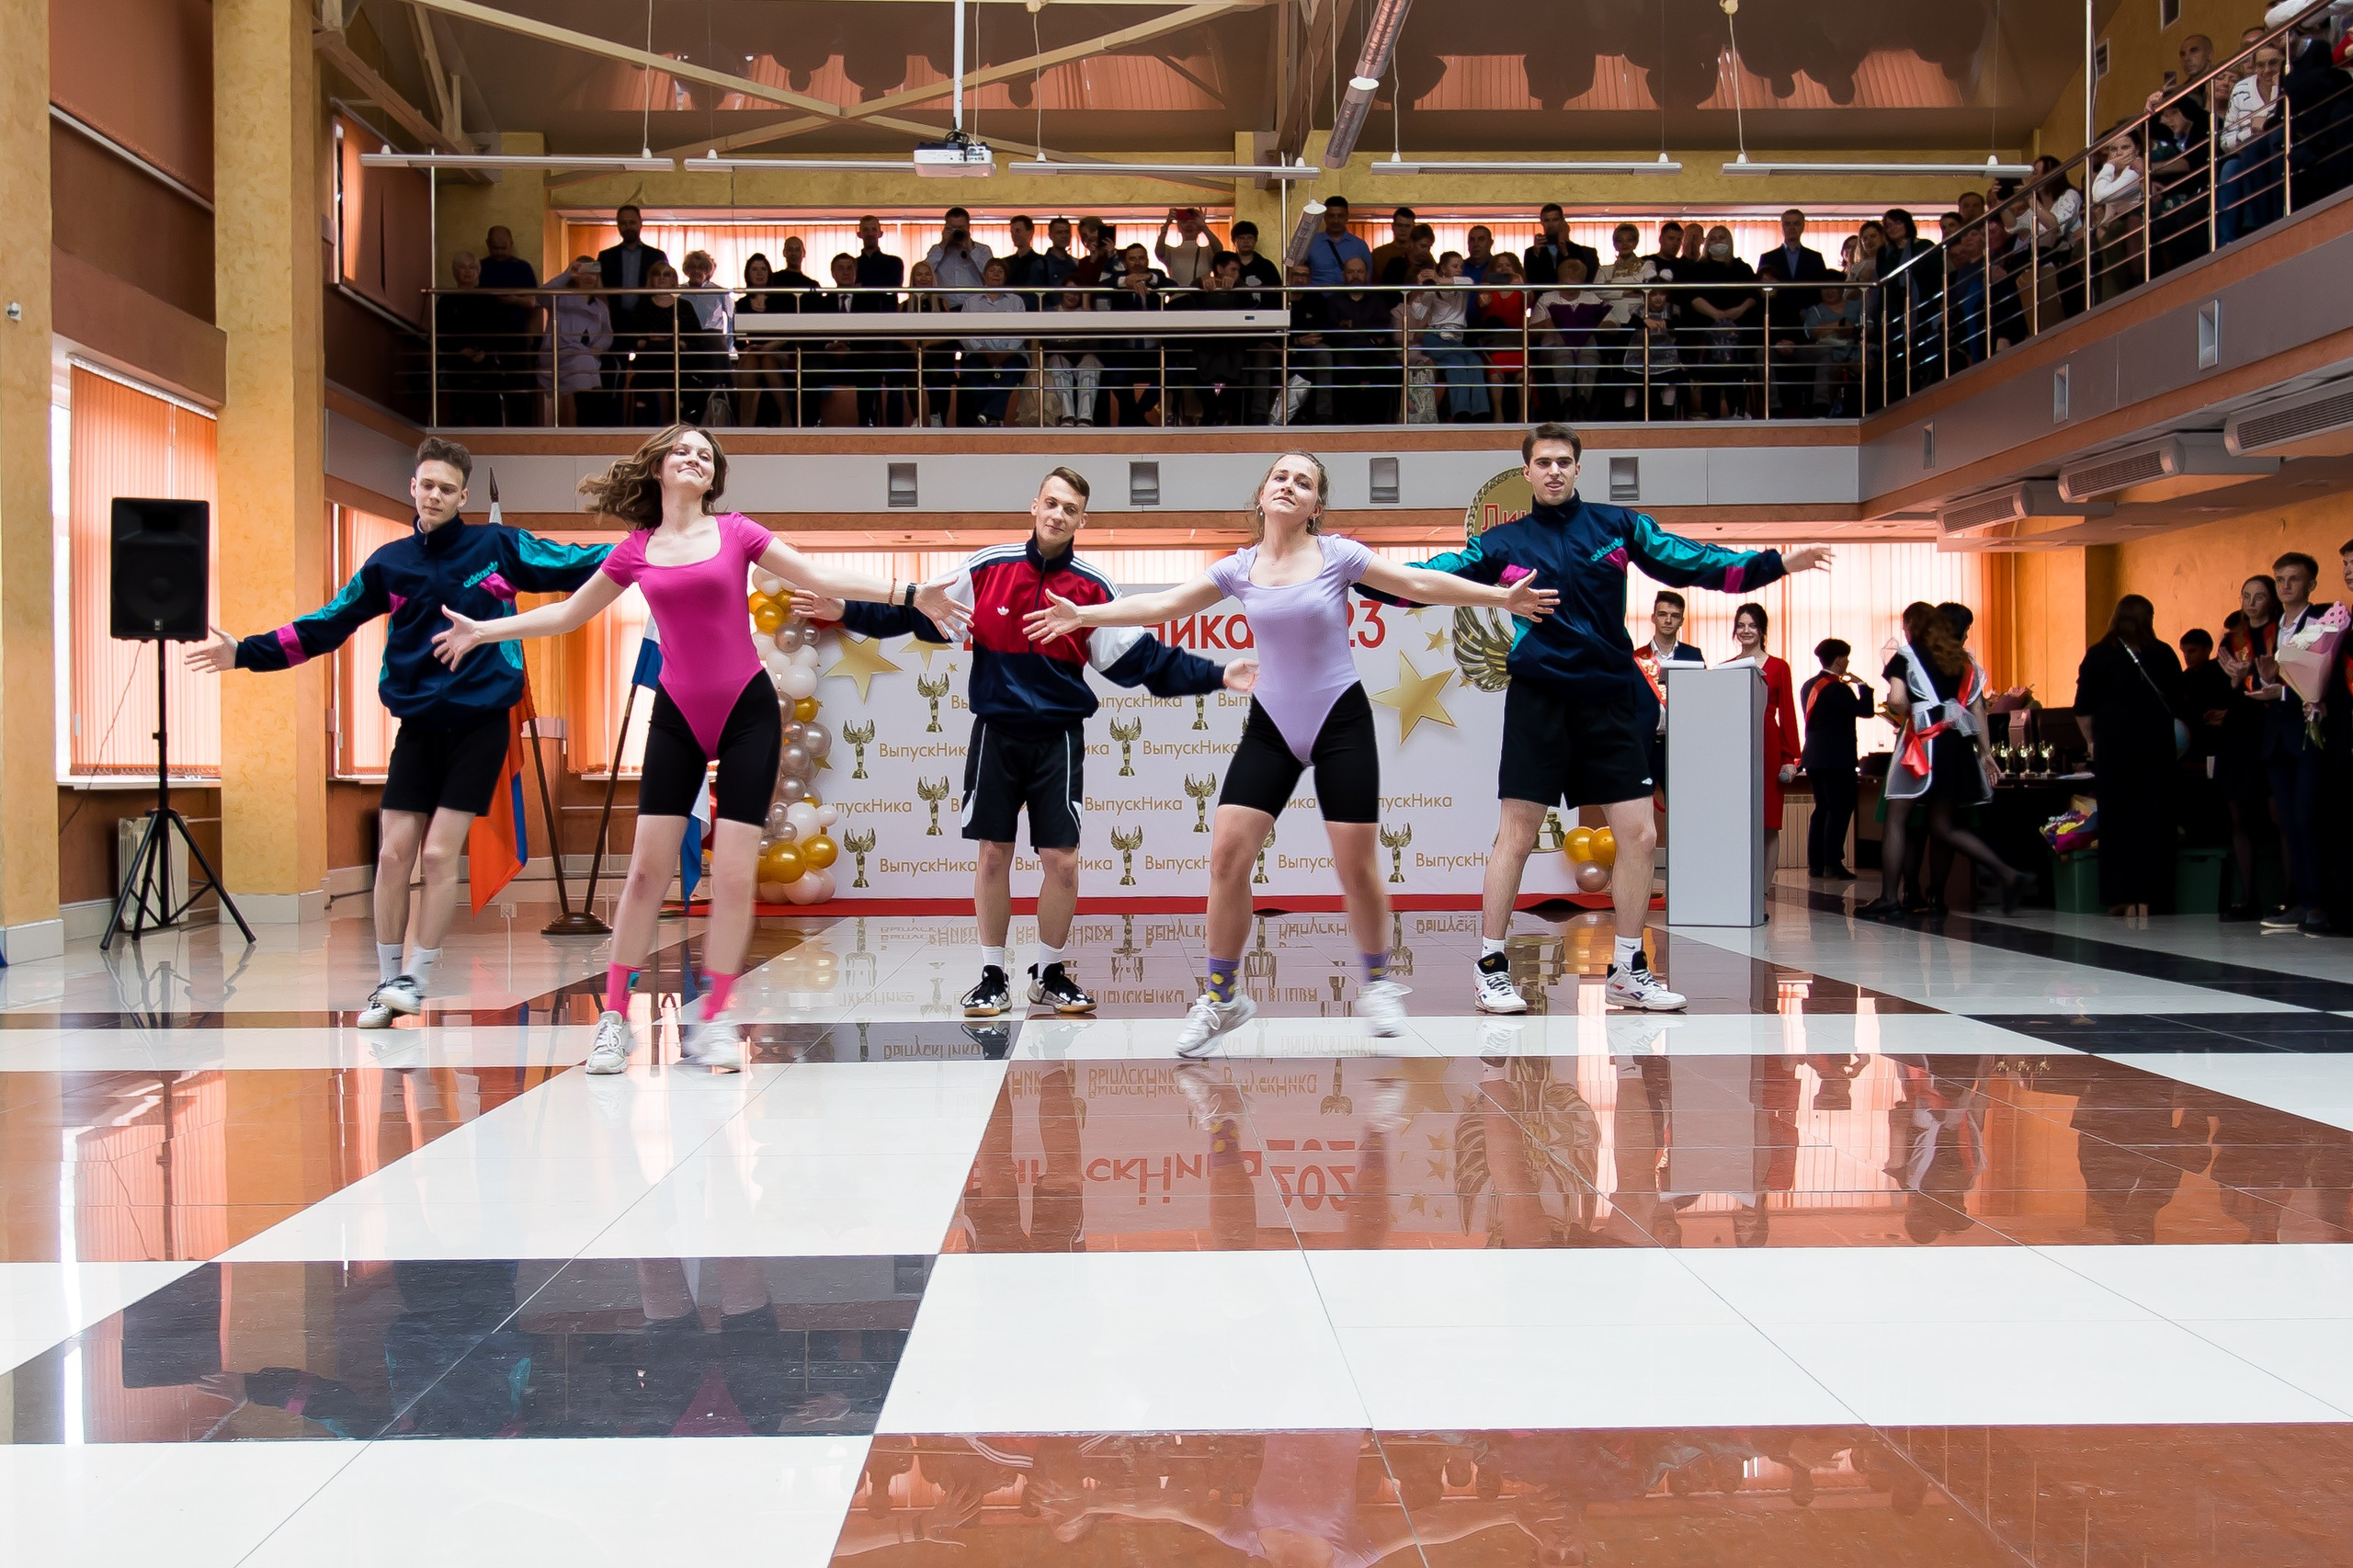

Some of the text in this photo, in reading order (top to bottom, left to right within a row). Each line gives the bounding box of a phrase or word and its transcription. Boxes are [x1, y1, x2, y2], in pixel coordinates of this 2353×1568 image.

[1098, 693, 1183, 713] ыпускНика
[879, 742, 967, 762] ВыпускНик
[1085, 795, 1183, 816] ВыпускНика
[879, 857, 977, 878] ВыпускНика
[1144, 854, 1211, 875] ВыпускН
[1278, 853, 1336, 874] Выпуск
